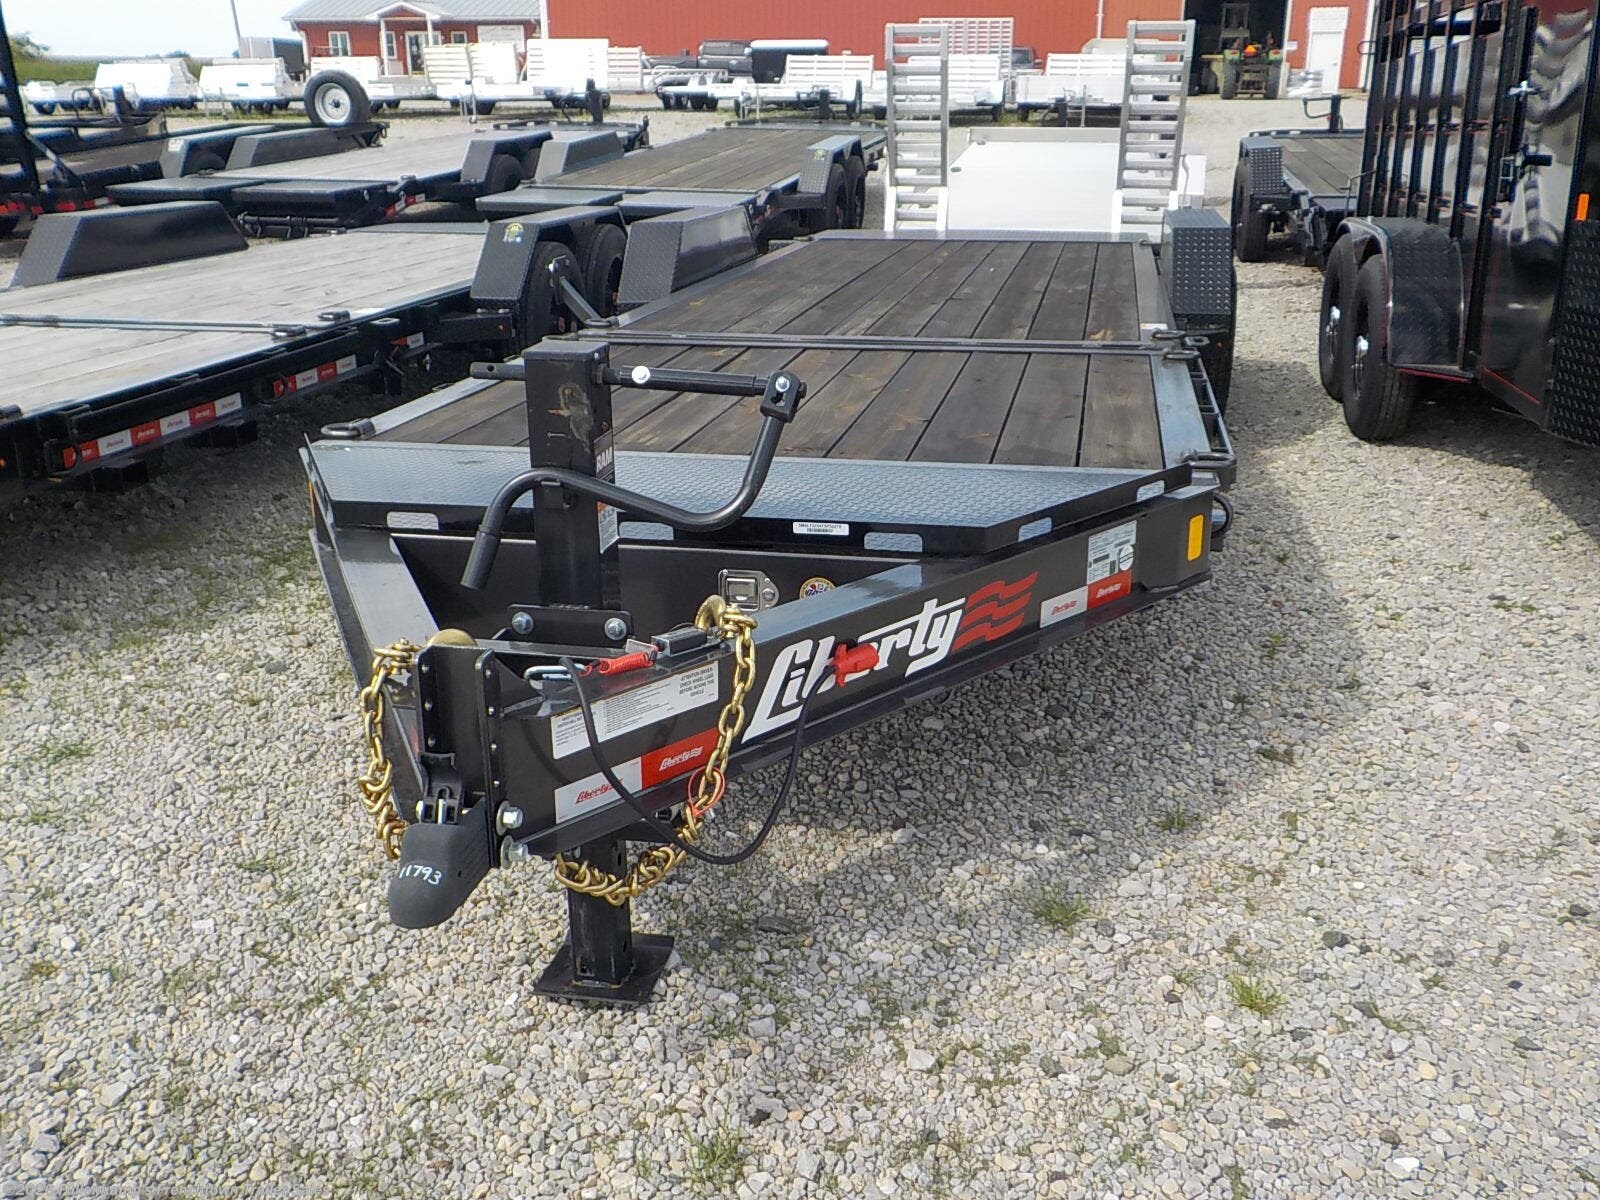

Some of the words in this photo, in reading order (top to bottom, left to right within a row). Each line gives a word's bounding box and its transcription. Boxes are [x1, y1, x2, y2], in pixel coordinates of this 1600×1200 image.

[596, 446, 613, 473] RAM
[659, 751, 691, 771] Liberty
[576, 783, 609, 804] Liberty
[399, 865, 442, 884] 11793
